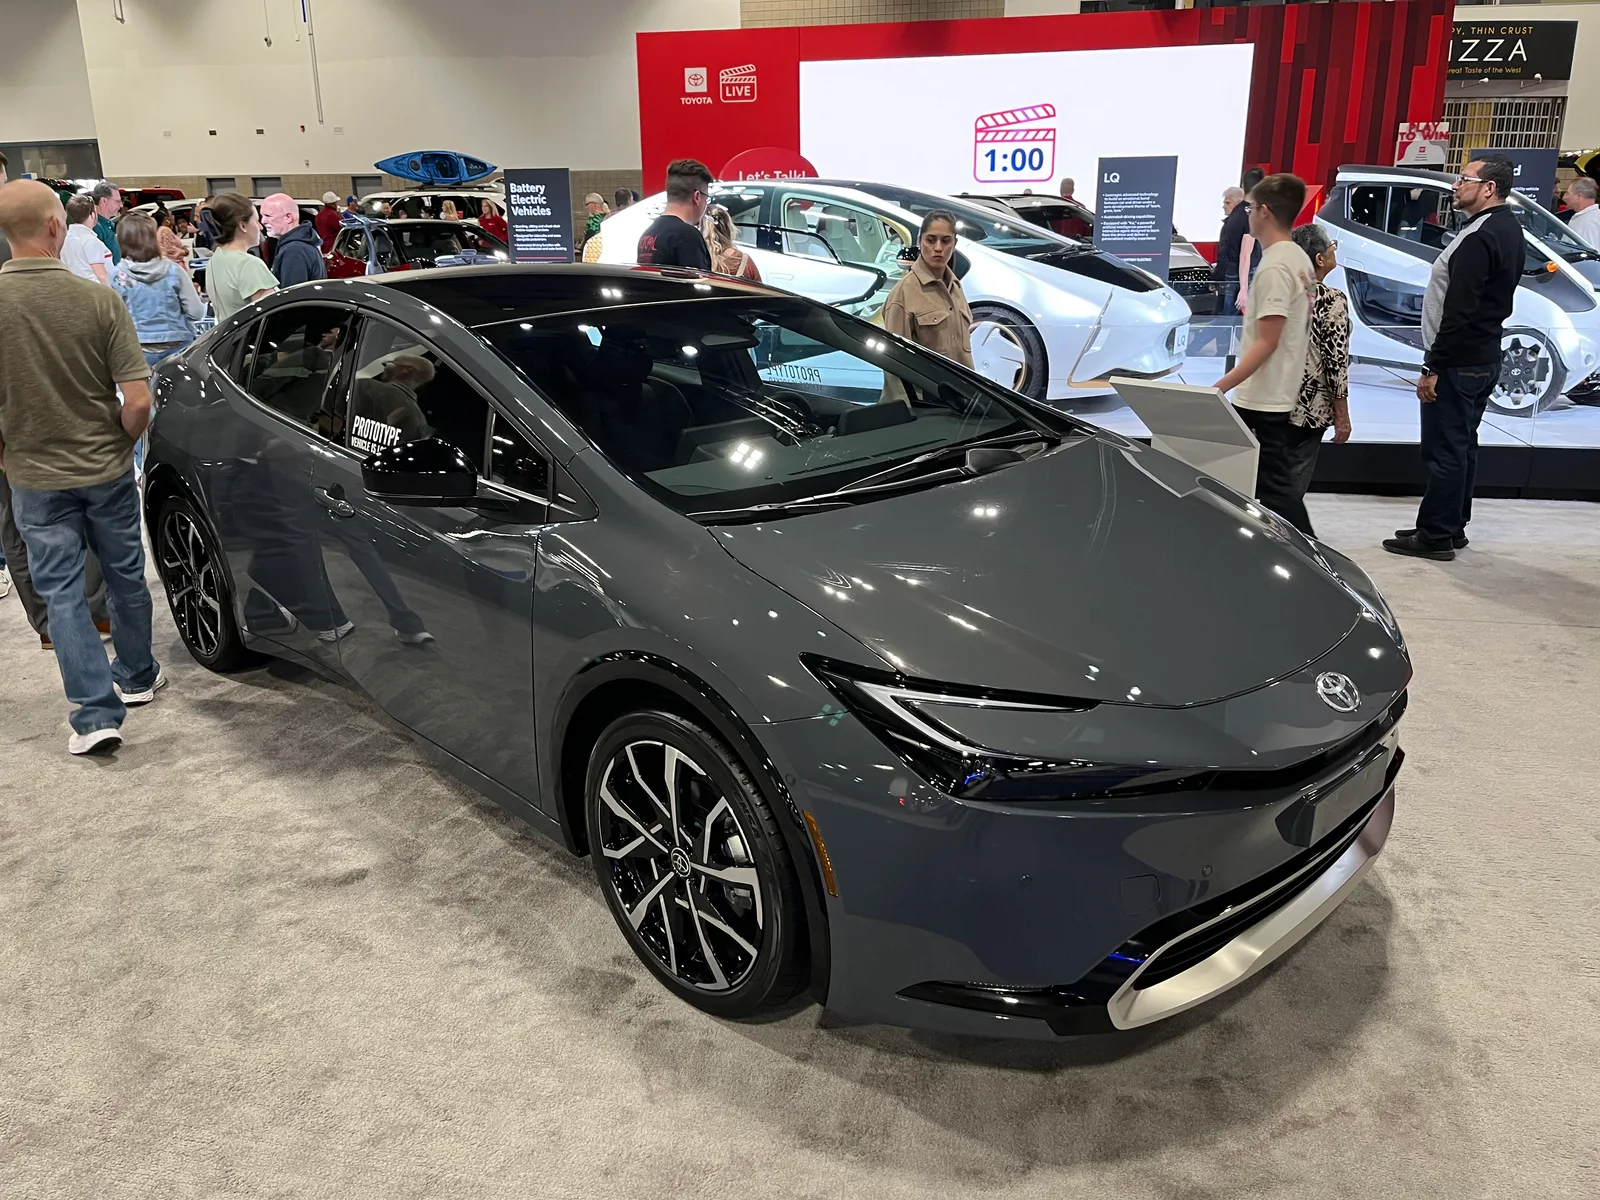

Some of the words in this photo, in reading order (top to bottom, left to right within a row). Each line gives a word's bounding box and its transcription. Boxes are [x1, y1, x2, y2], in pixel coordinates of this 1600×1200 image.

[1471, 27, 1495, 35] THIN
[1500, 26, 1534, 35] CRUST
[1448, 38, 1527, 61] IZZA
[725, 86, 751, 96] LIVE
[680, 96, 713, 105] TOYOTA
[1399, 132, 1416, 140] TO
[1421, 131, 1449, 140] WIN
[984, 148, 1044, 172] 1:00
[1103, 172, 1120, 183] LQ
[509, 183, 545, 195] Battery
[510, 194, 547, 204] Electric
[511, 205, 551, 216] Vehicles
[351, 415, 402, 446] PROTOTYPE
[351, 436, 371, 452] VEHICLE
